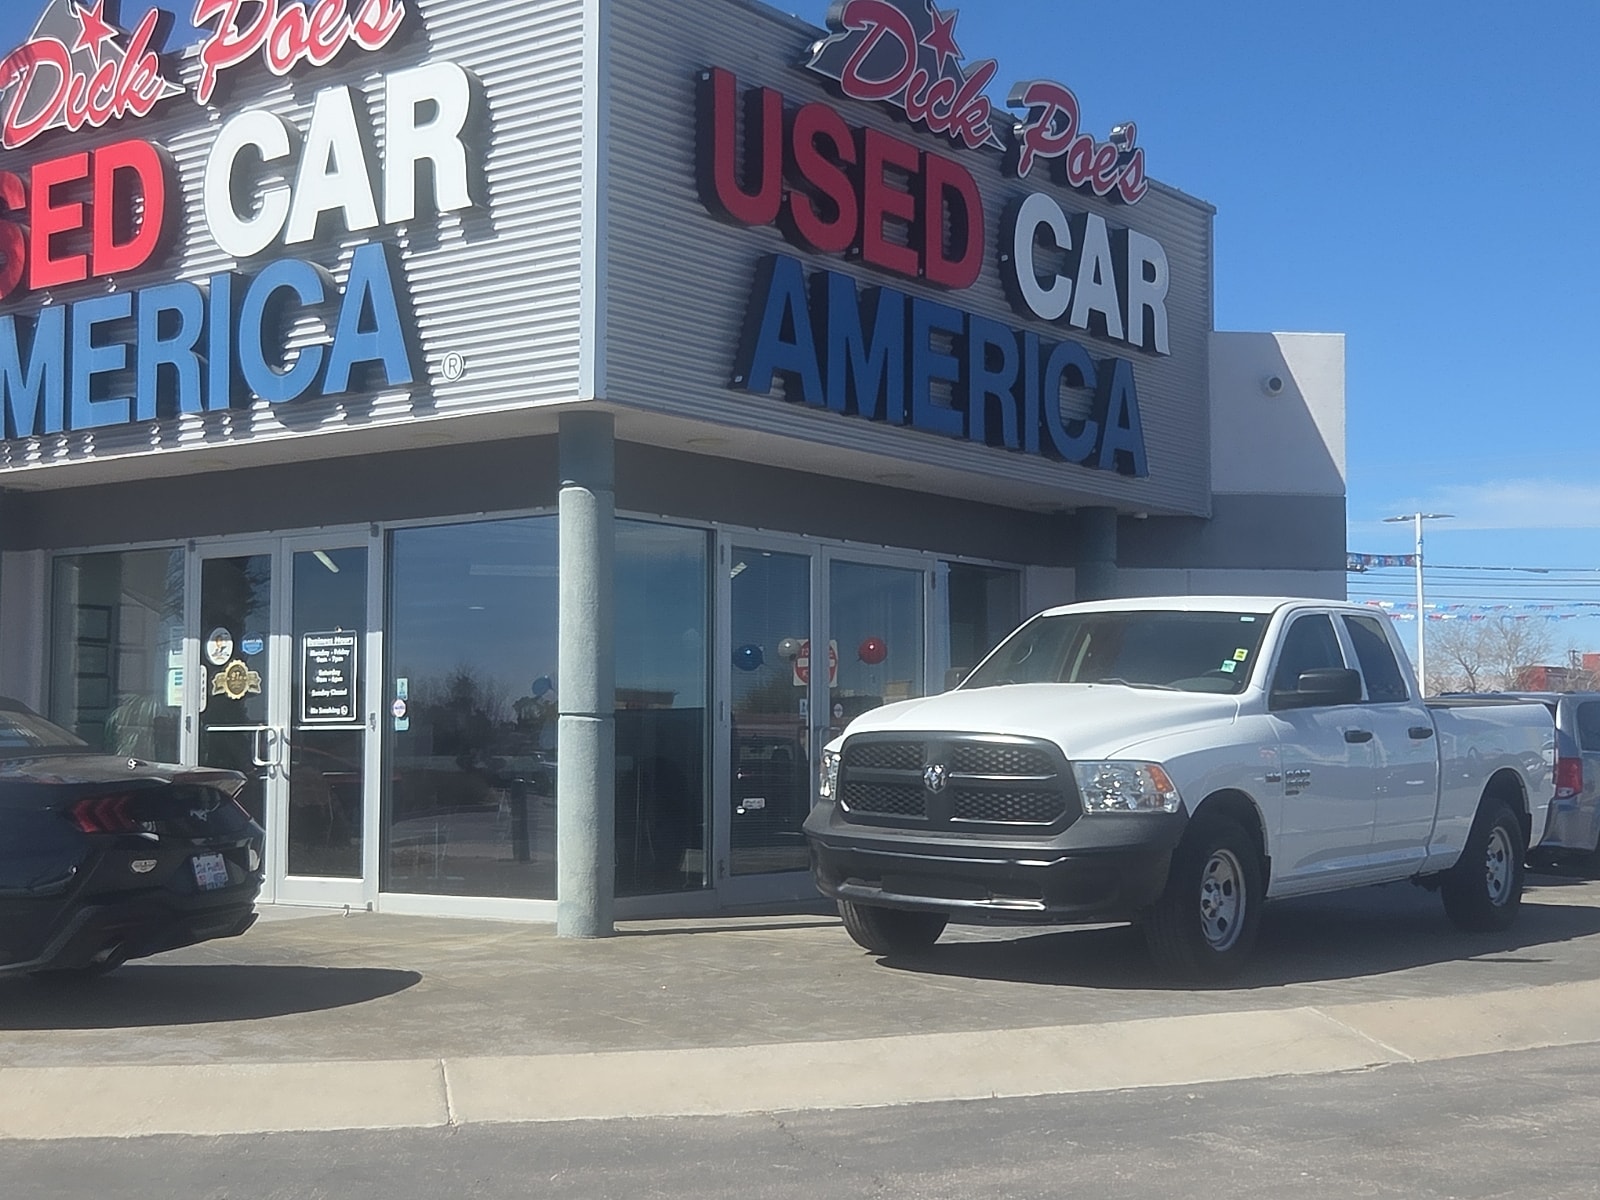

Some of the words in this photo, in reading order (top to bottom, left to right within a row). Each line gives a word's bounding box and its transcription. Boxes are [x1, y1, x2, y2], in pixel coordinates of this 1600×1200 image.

[0, 8, 165, 150] Dick
[190, 0, 406, 105] Poes
[203, 61, 473, 258] CAR
[841, 0, 998, 149] Dick
[1018, 79, 1149, 205] Poe's
[713, 66, 985, 291] USED
[1013, 192, 1171, 356] CAR
[747, 253, 1150, 479] AMERICA
